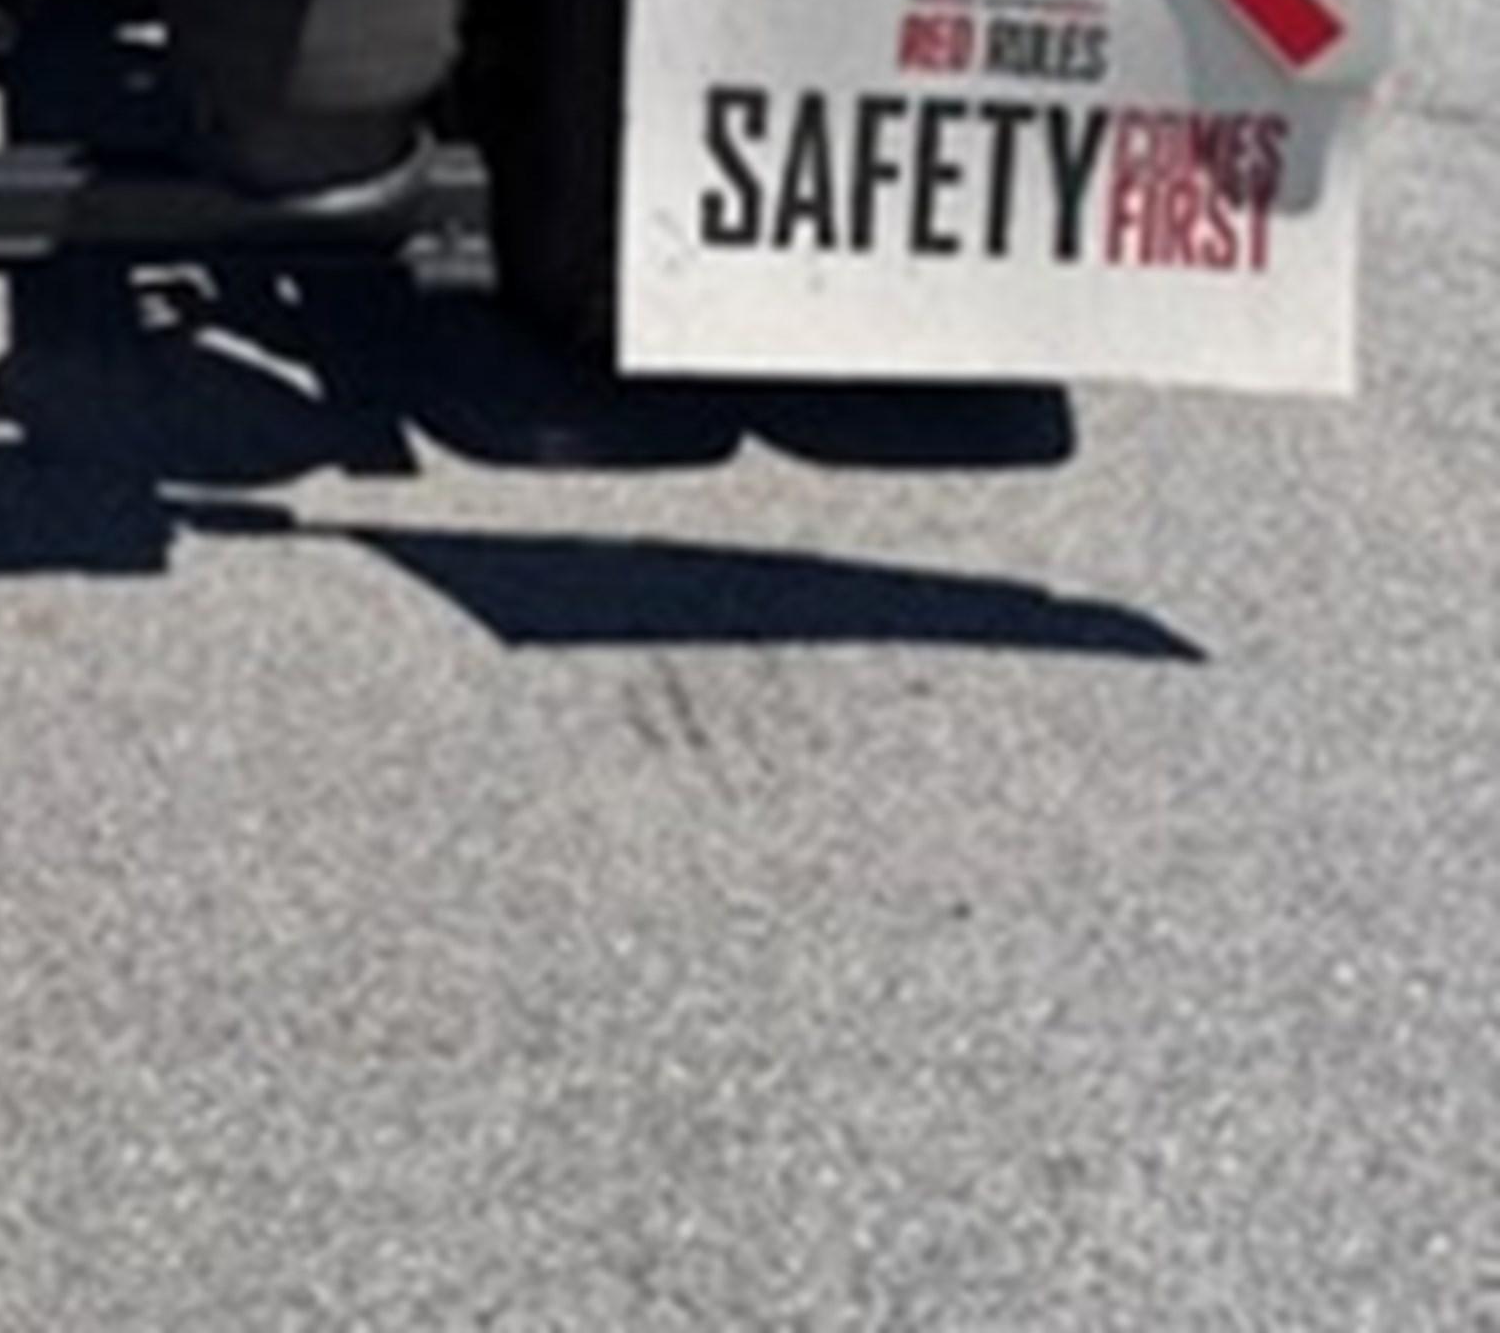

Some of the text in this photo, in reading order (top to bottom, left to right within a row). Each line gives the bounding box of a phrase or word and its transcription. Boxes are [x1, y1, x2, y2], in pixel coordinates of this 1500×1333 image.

[897, 13, 1110, 83] RED RULES
[699, 85, 1109, 265] SAFETY
[1104, 176, 1276, 273] FIRST
